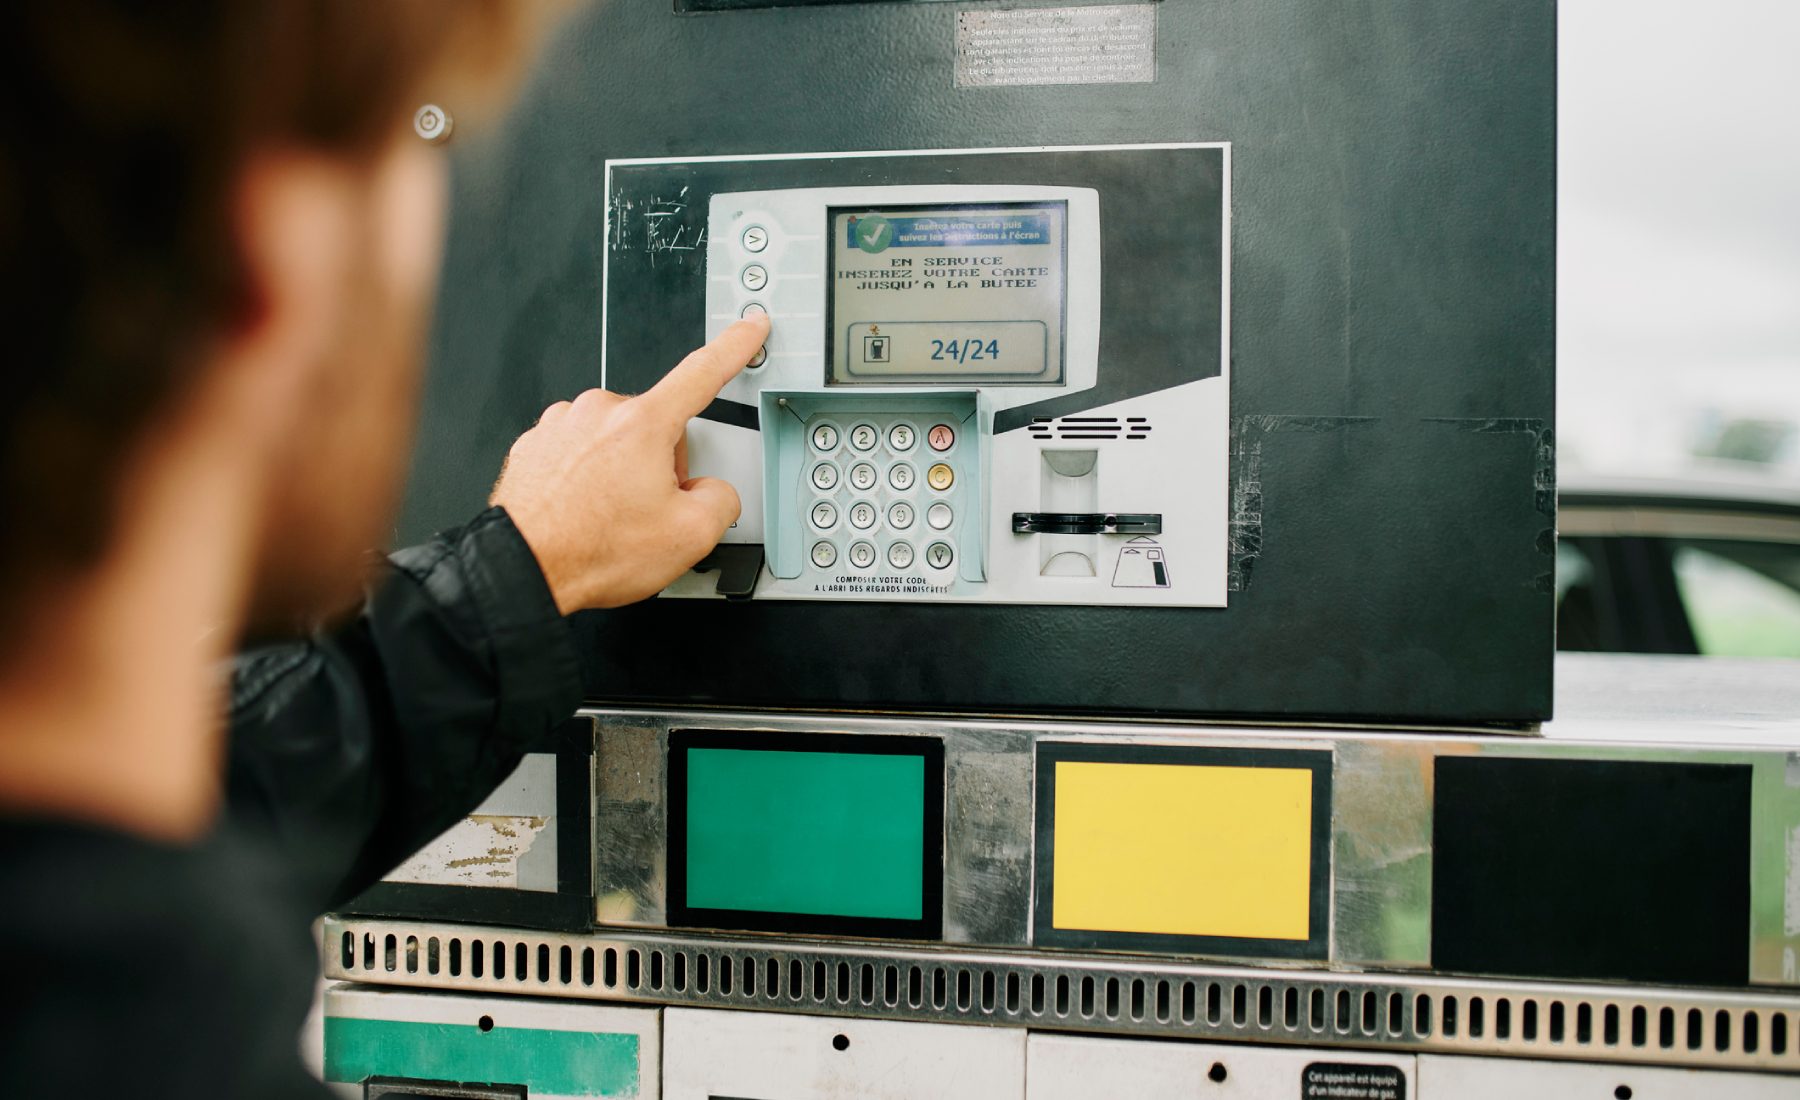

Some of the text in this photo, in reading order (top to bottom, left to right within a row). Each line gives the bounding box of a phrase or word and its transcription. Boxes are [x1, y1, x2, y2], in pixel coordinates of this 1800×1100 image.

[1076, 8, 1120, 17] Métroogie
[1012, 26, 1055, 34] indications
[1070, 25, 1085, 34] prix
[1064, 54, 1087, 63] poste
[980, 66, 1028, 74] distributeur
[950, 222, 975, 230] votre
[977, 221, 1000, 229] carte
[1002, 220, 1022, 231] puis
[899, 233, 928, 241] suivez
[930, 232, 942, 241] les
[1001, 230, 1007, 239] à
[1009, 228, 1040, 239] l'écran
[891, 256, 1003, 267] EN SERVICE
[838, 267, 1049, 279] INSEREZ VOTRE CARTE
[946, 280, 968, 289] LA
[981, 279, 1038, 289] BUTEE
[930, 338, 1000, 364] 24/24
[821, 430, 946, 446] 1 2 3 A
[819, 470, 830, 484] 4
[858, 470, 868, 484] 5
[934, 470, 946, 484] C
[820, 509, 906, 523] 7 8 9
[934, 550, 944, 563] V
[880, 576, 903, 584] VOTRE
[1308, 1070, 1398, 1086] Cet appareil est équipé
[1308, 1084, 1397, 1100] d'un indicateur de gaz.
